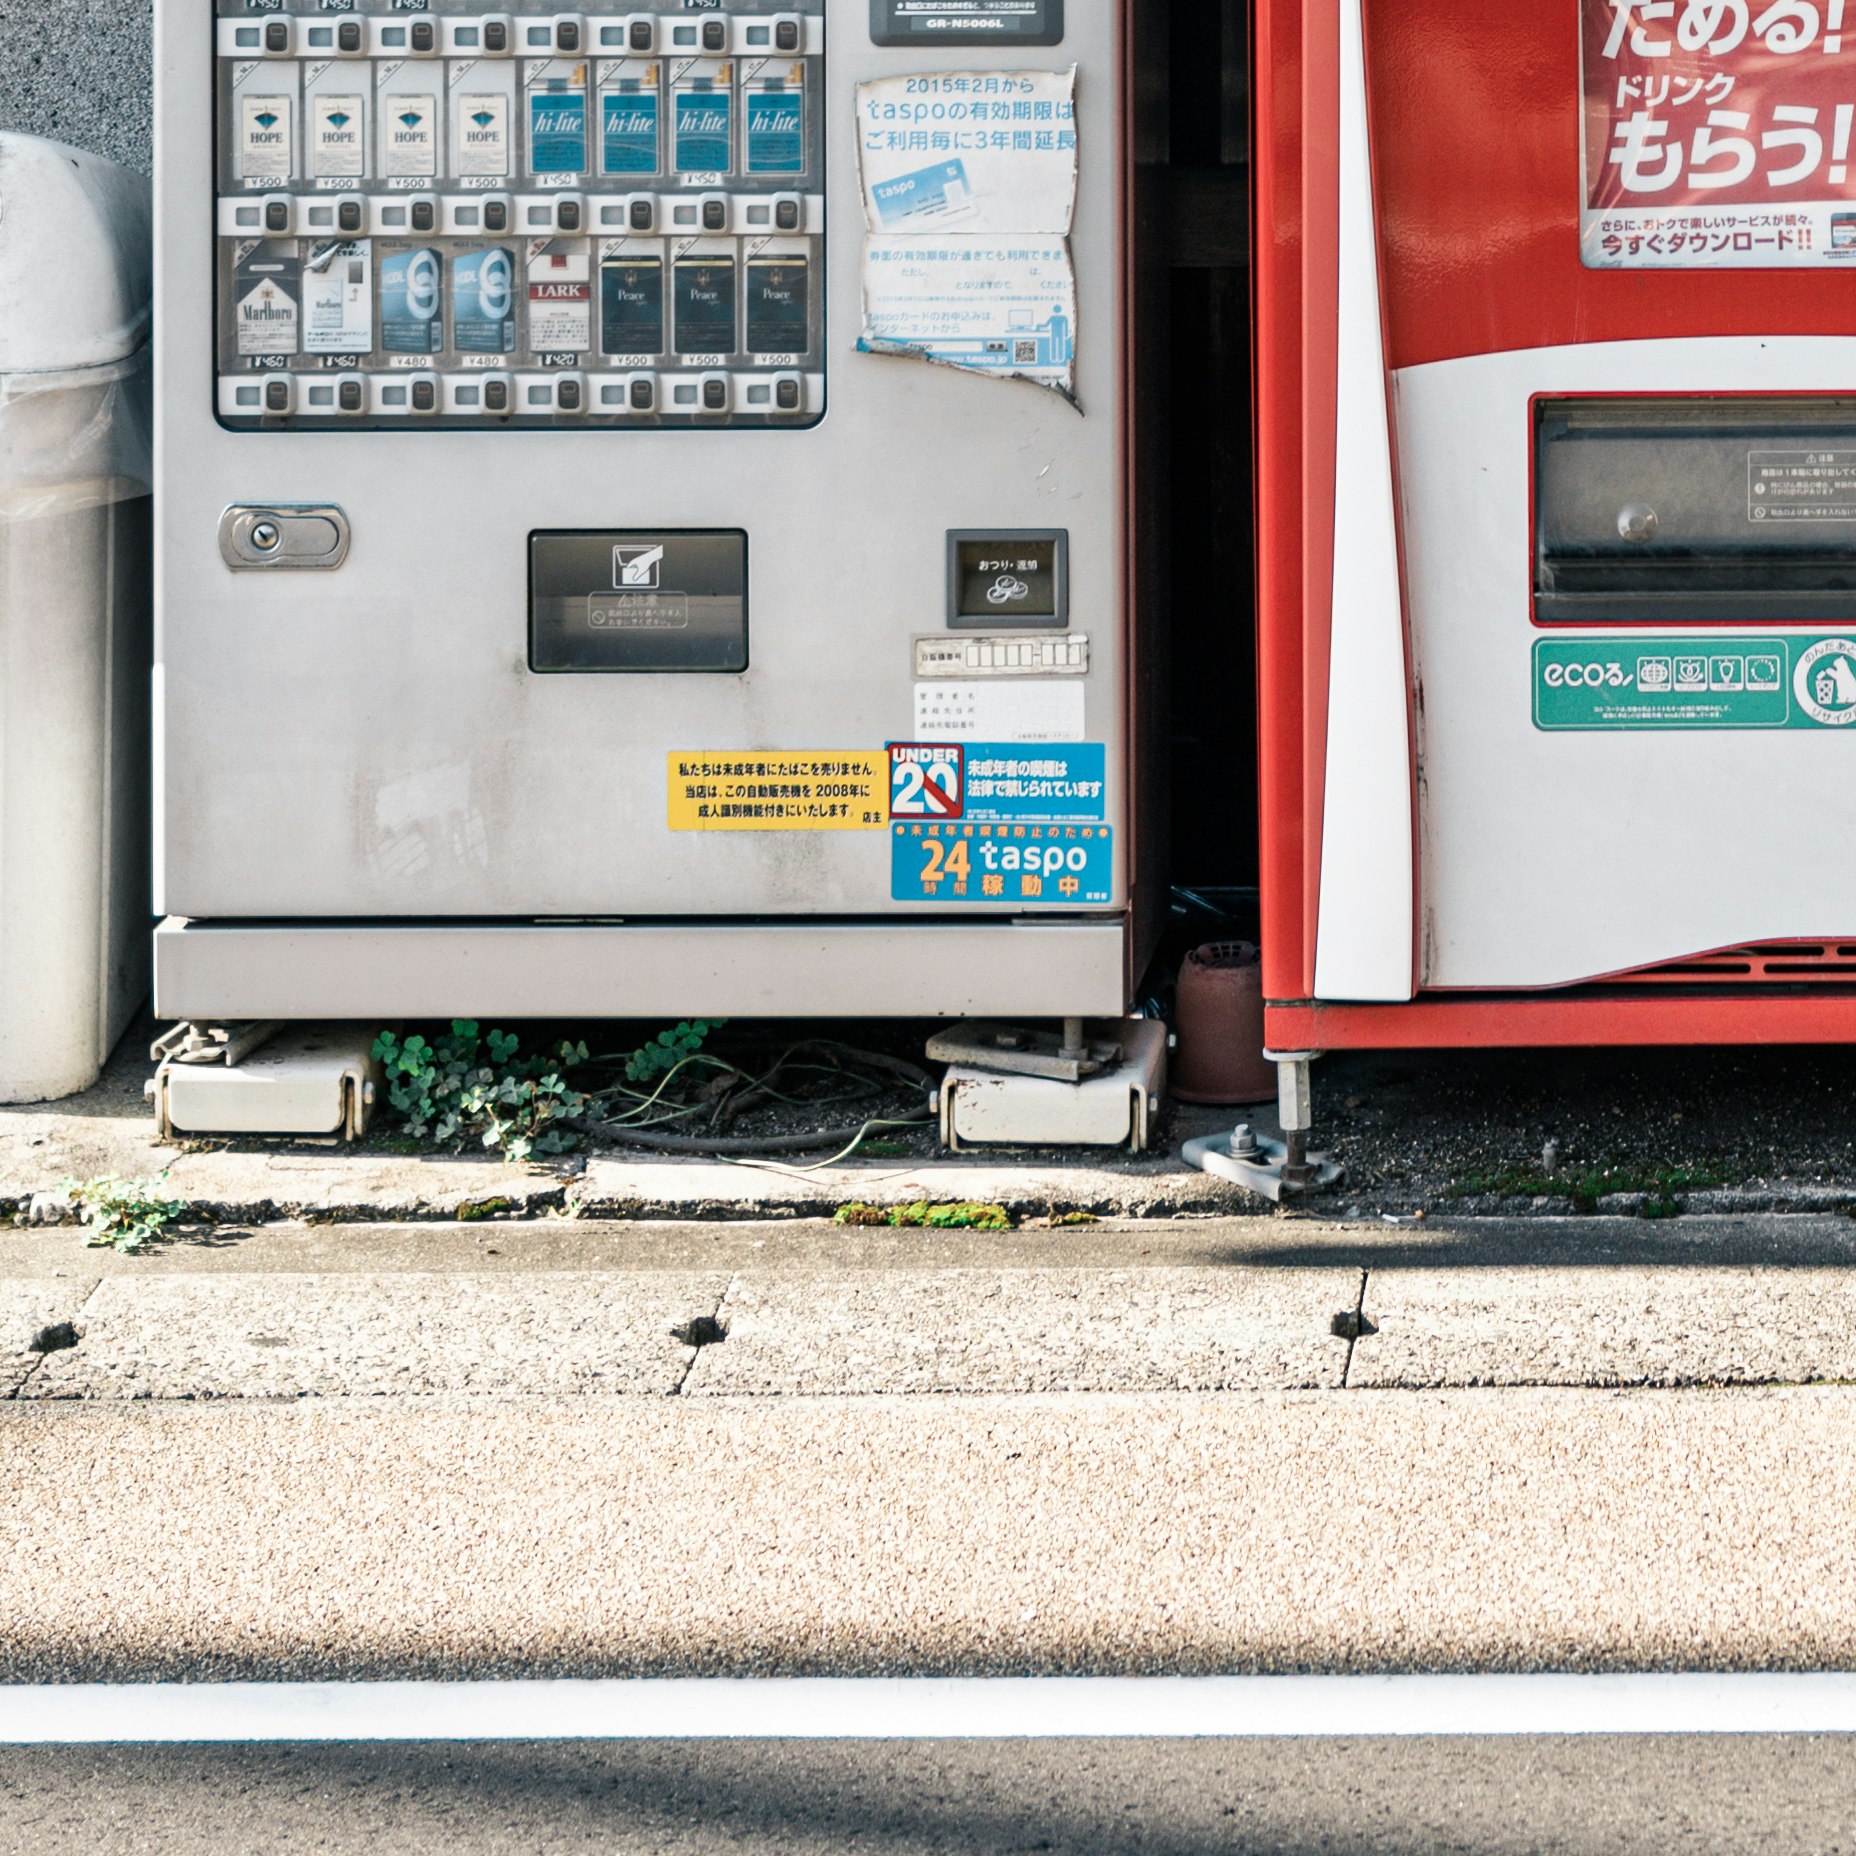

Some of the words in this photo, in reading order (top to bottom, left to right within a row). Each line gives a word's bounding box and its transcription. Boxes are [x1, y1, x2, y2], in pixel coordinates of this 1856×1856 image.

[907, 78, 1034, 93] 2015年2月から
[1616, 72, 1736, 107] ドリンク
[868, 100, 1074, 121] taspoの有効期限は
[535, 112, 581, 132] hi-lite
[250, 132, 283, 144] HOPE
[866, 130, 1076, 150] ご利用毎に3年間延長
[1609, 104, 1854, 193] もらう!
[537, 284, 580, 298] LARK
[618, 290, 644, 300] Peace
[243, 303, 291, 320] Marlboro
[893, 748, 958, 763] UNDER
[679, 763, 878, 778] 私たちは未成年者にたばこを売りません。
[968, 760, 1067, 777] 未成年者の喫煙は
[892, 762, 958, 815] 20
[968, 779, 1102, 798] 法律で禁じられています
[698, 804, 854, 818] 成人識別機能付きにいたします。
[863, 812, 881, 823] 店主
[920, 840, 970, 881] 24
[979, 842, 1087, 877] taspo
[982, 875, 1079, 896] 稼動中
